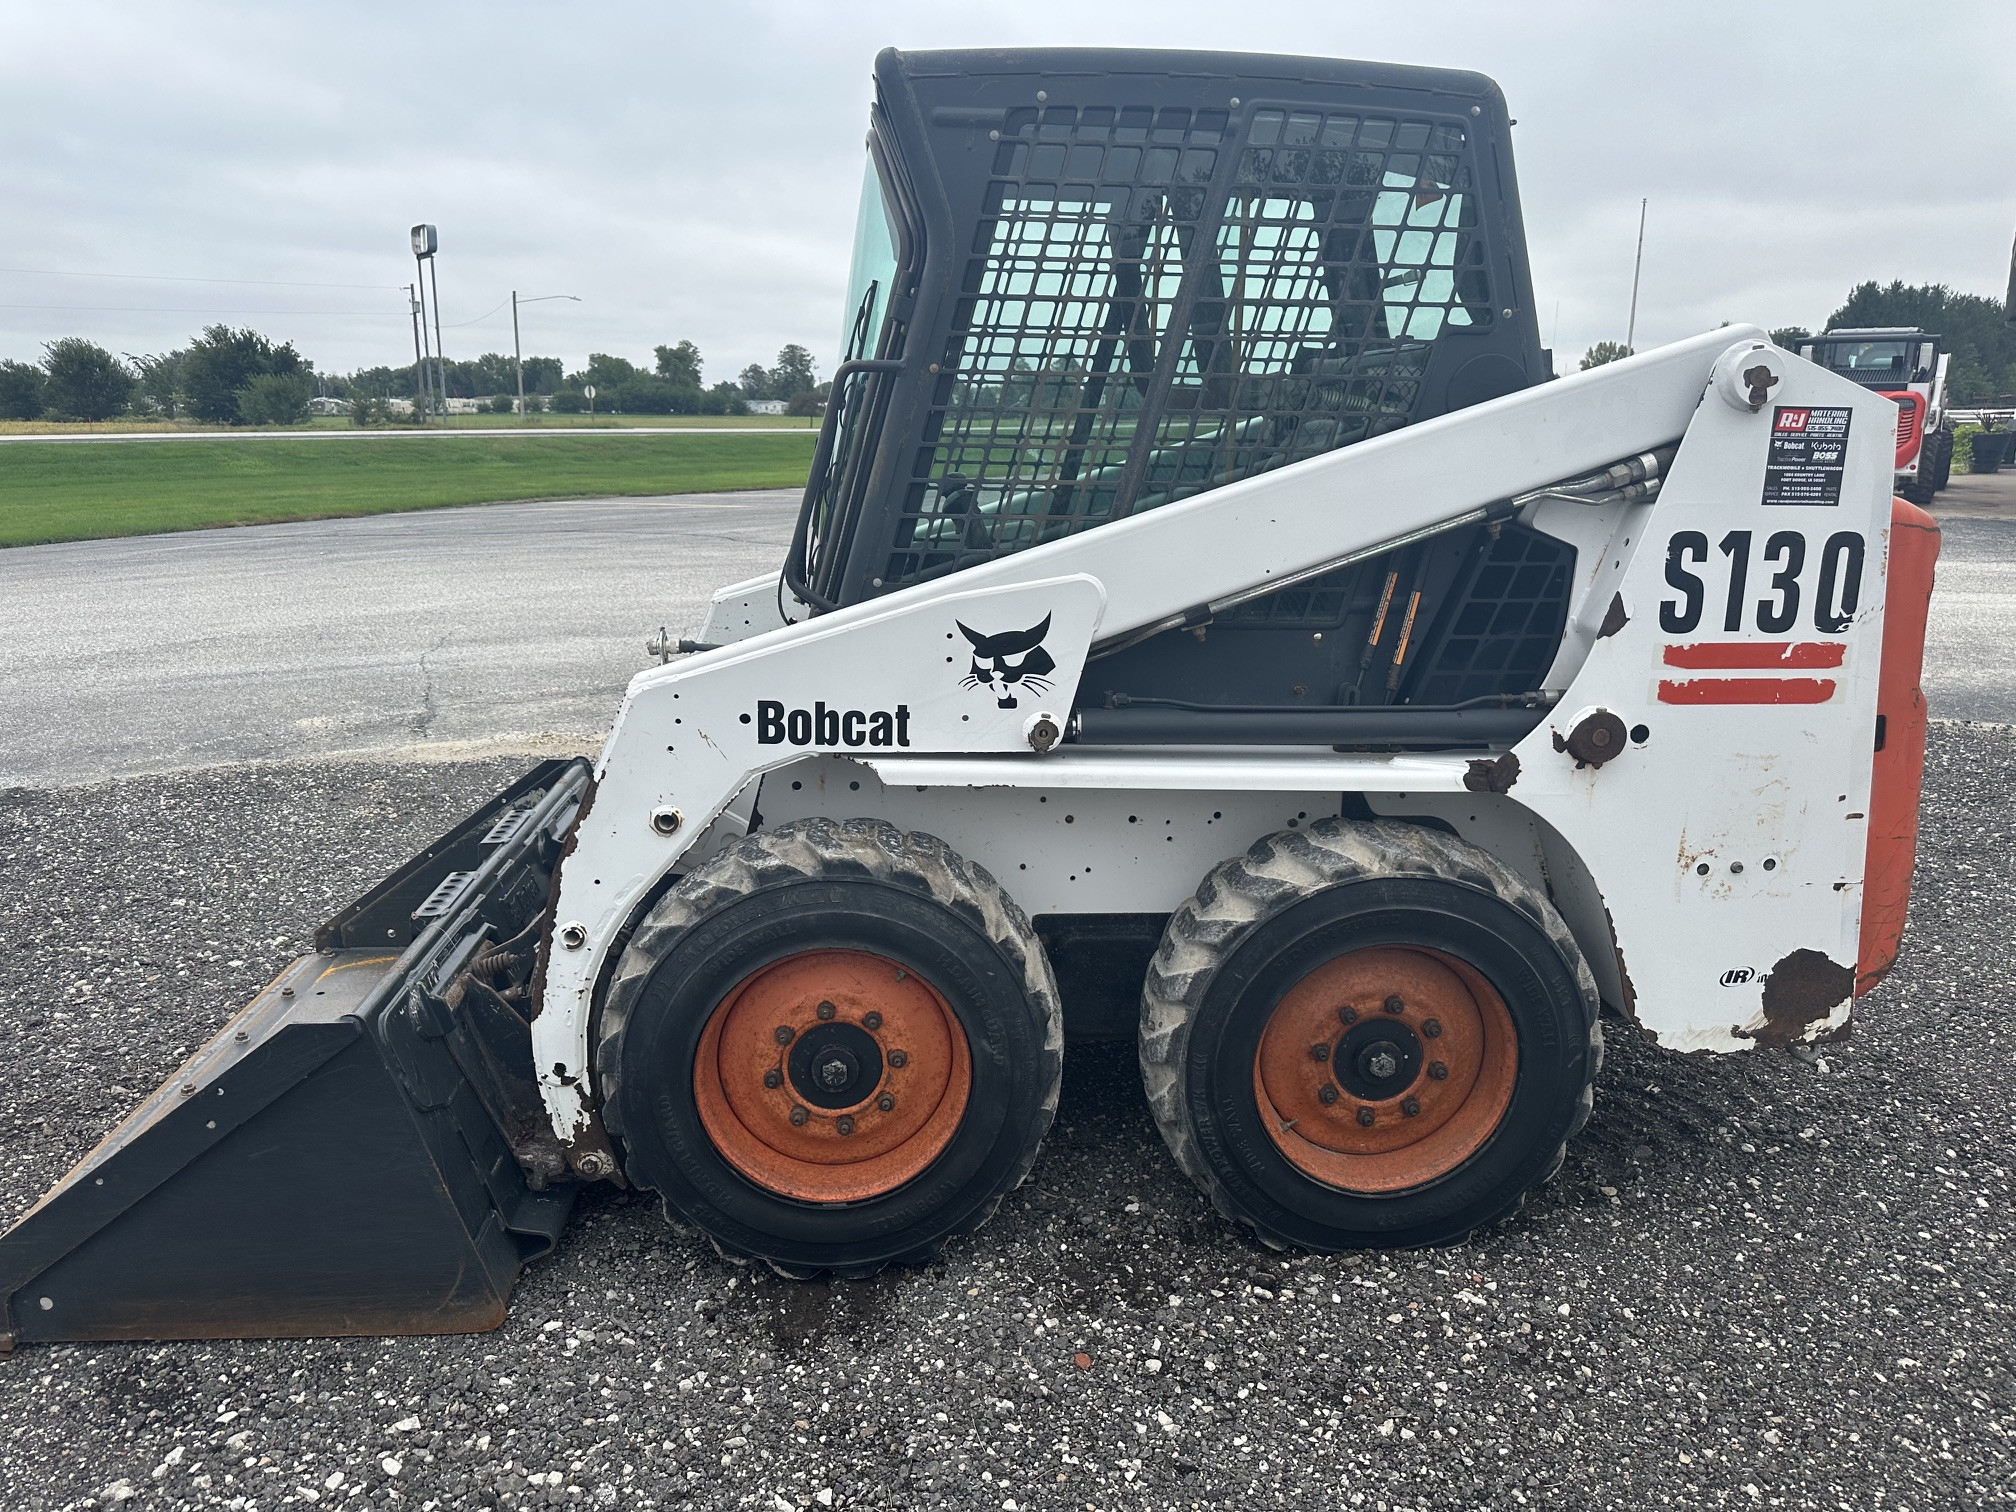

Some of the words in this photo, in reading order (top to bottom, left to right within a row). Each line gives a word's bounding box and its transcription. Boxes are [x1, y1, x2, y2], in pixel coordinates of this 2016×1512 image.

[1779, 412, 1806, 427] R&J
[1784, 442, 1805, 450] Bobcat
[1810, 442, 1842, 450] Kubota
[1659, 530, 1865, 634] S130
[757, 700, 910, 746] Bobcat
